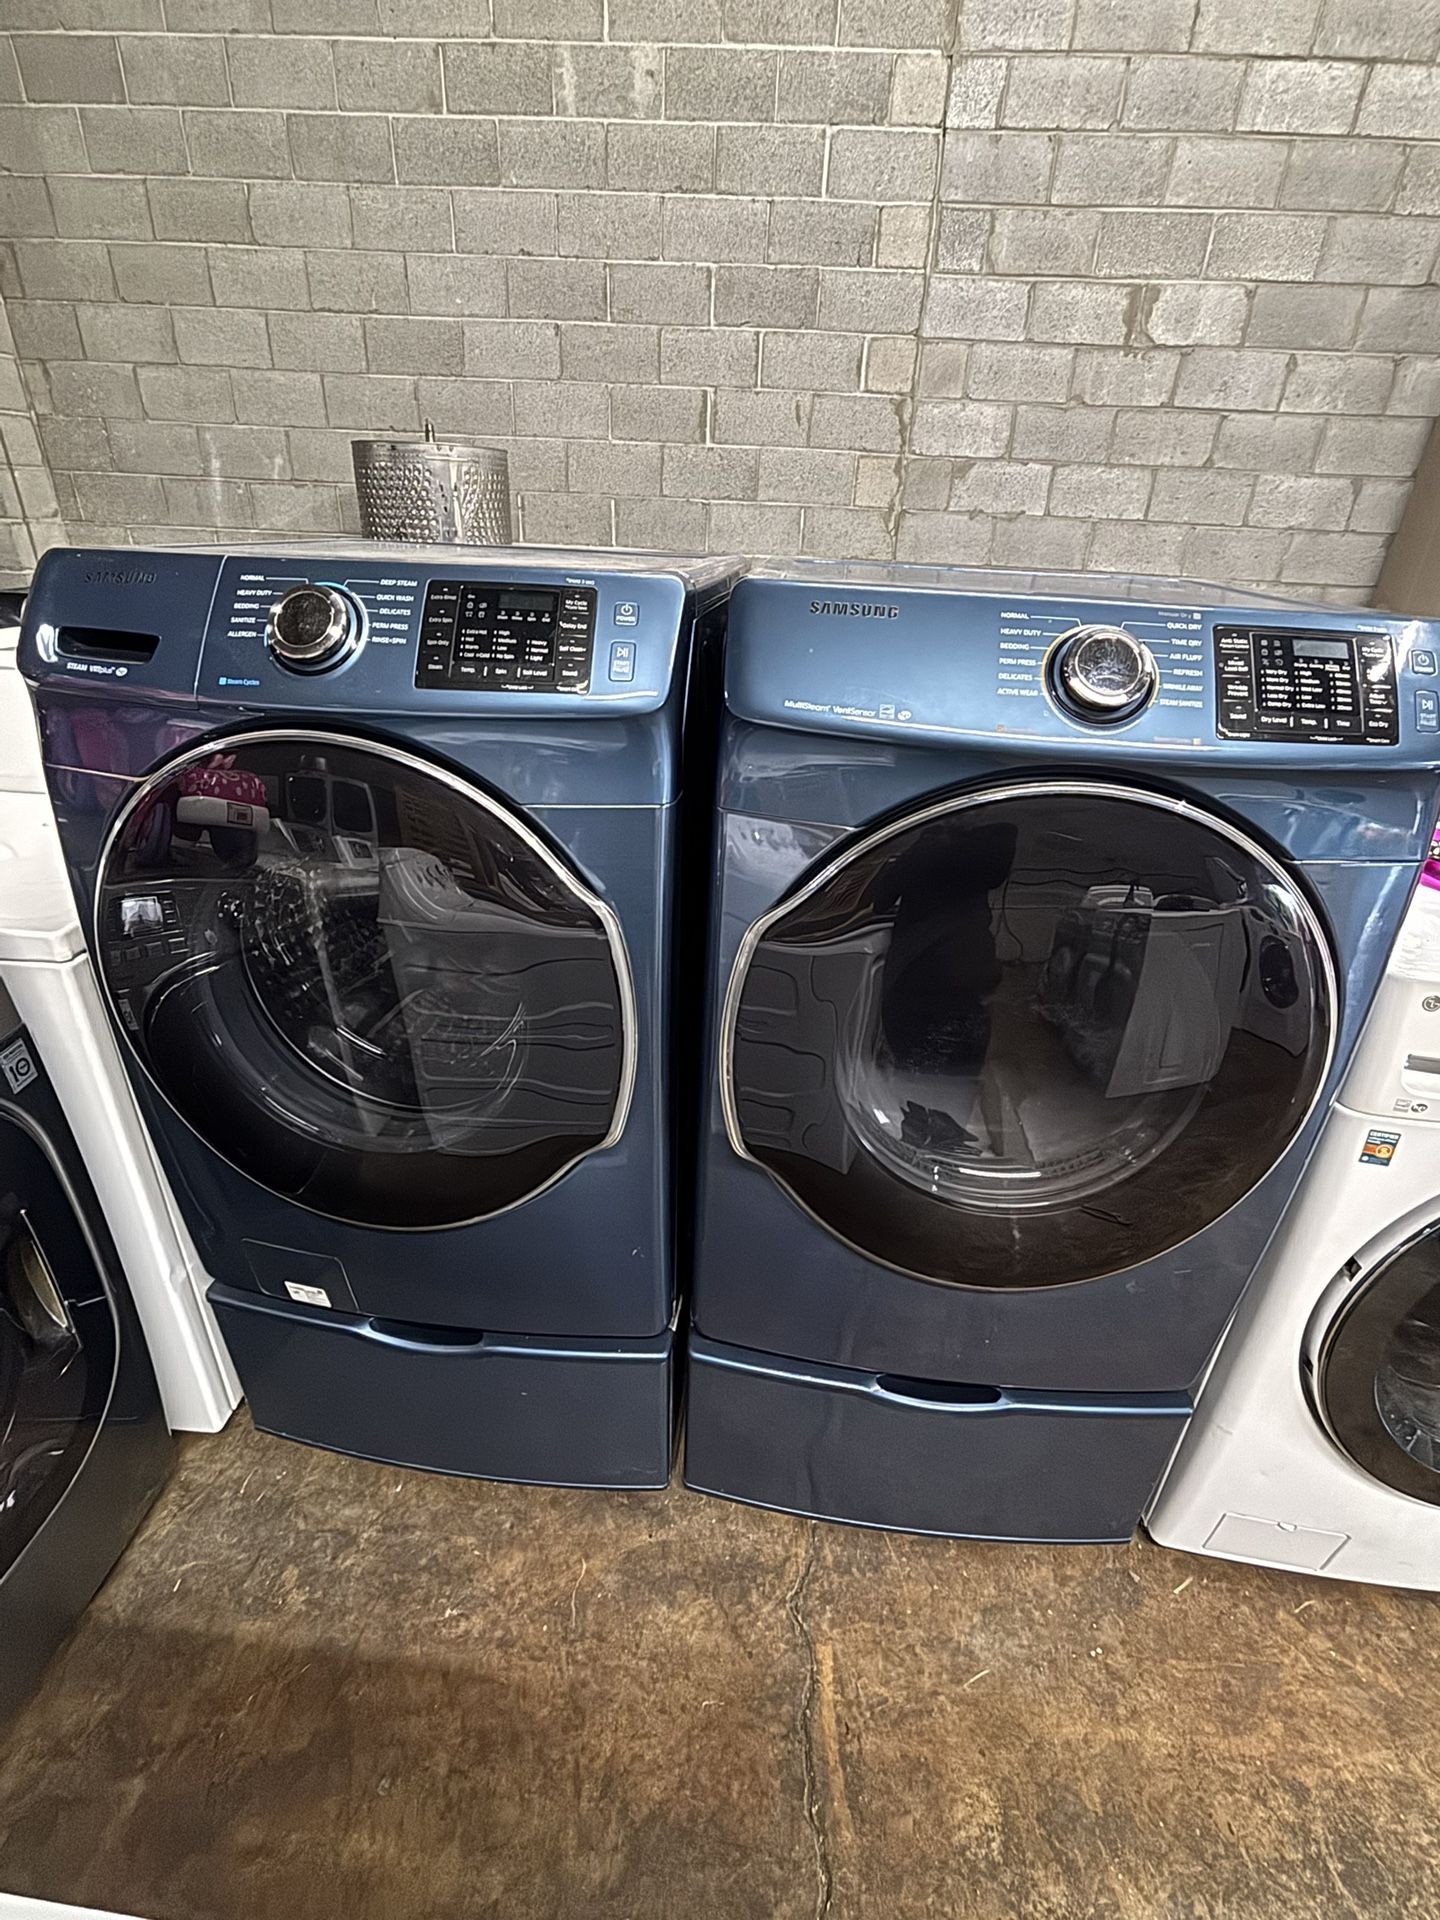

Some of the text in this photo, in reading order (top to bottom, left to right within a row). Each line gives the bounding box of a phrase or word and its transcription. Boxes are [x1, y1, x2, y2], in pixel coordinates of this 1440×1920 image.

[240, 574, 265, 582] NORMAL
[380, 578, 418, 587] DEEP STEAM
[376, 593, 414, 602] QUICK WASH
[233, 602, 260, 610] BEDDING
[808, 599, 899, 620] SAMSUNG
[379, 607, 411, 616] DELICATES
[1000, 612, 1030, 620] NORMAL
[230, 616, 256, 624] SANITIZE
[371, 621, 409, 631] PERM PRESS
[1166, 622, 1202, 631] QUICK DRY
[227, 630, 257, 638] ALLERGEN
[1000, 628, 1042, 637] HEAVY DUTY
[1000, 642, 1030, 651] BEDDING
[1170, 638, 1202, 648] TIME DRY
[998, 657, 1037, 667] PERM PRESS
[1168, 653, 1203, 662] AIR FLUFF
[66, 662, 88, 671] STEAM
[998, 672, 1033, 682] DELICATES
[1172, 668, 1204, 677] REFRESH
[997, 687, 1039, 697] ACTIVE WEAR
[832, 705, 878, 718] VentSensor
[1260, 716, 1288, 724] Dry Level
